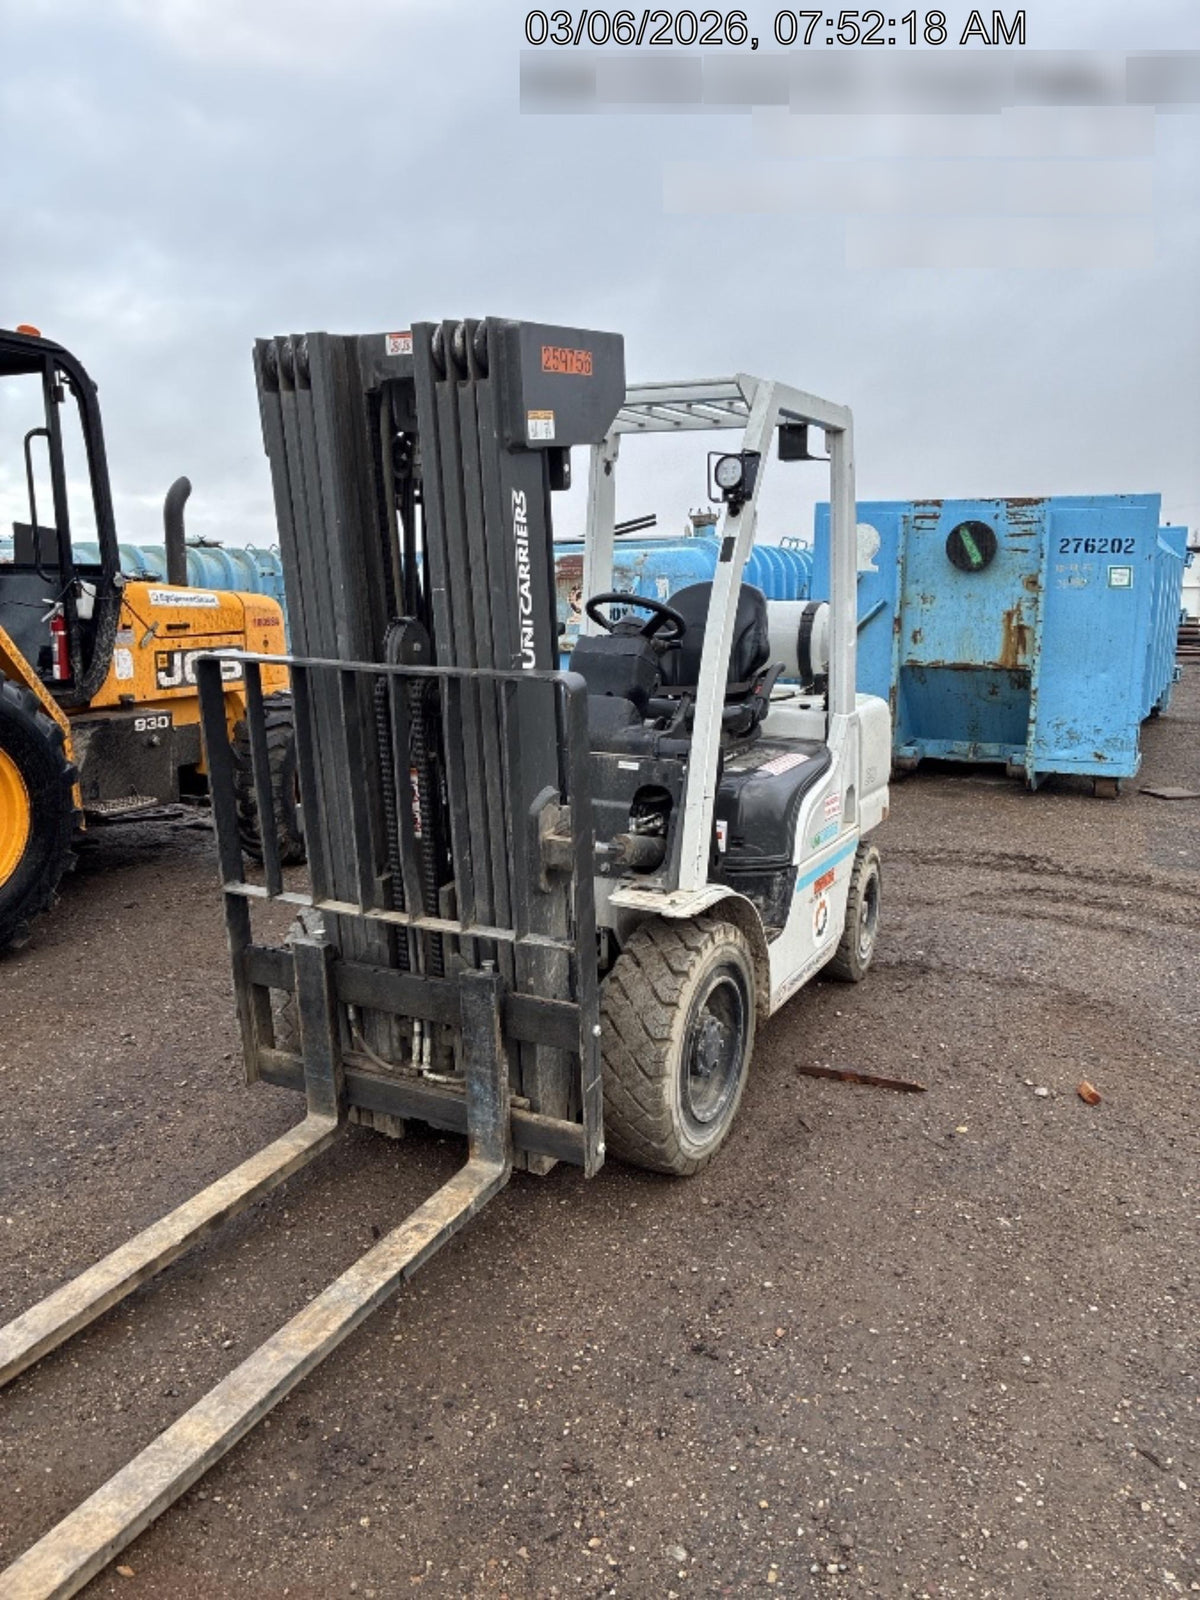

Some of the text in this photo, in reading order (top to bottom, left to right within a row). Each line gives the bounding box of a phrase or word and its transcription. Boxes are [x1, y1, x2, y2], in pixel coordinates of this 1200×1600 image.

[1059, 537, 1136, 554] 276202
[512, 488, 536, 670] UNICARRIERS
[134, 716, 169, 732] 930
